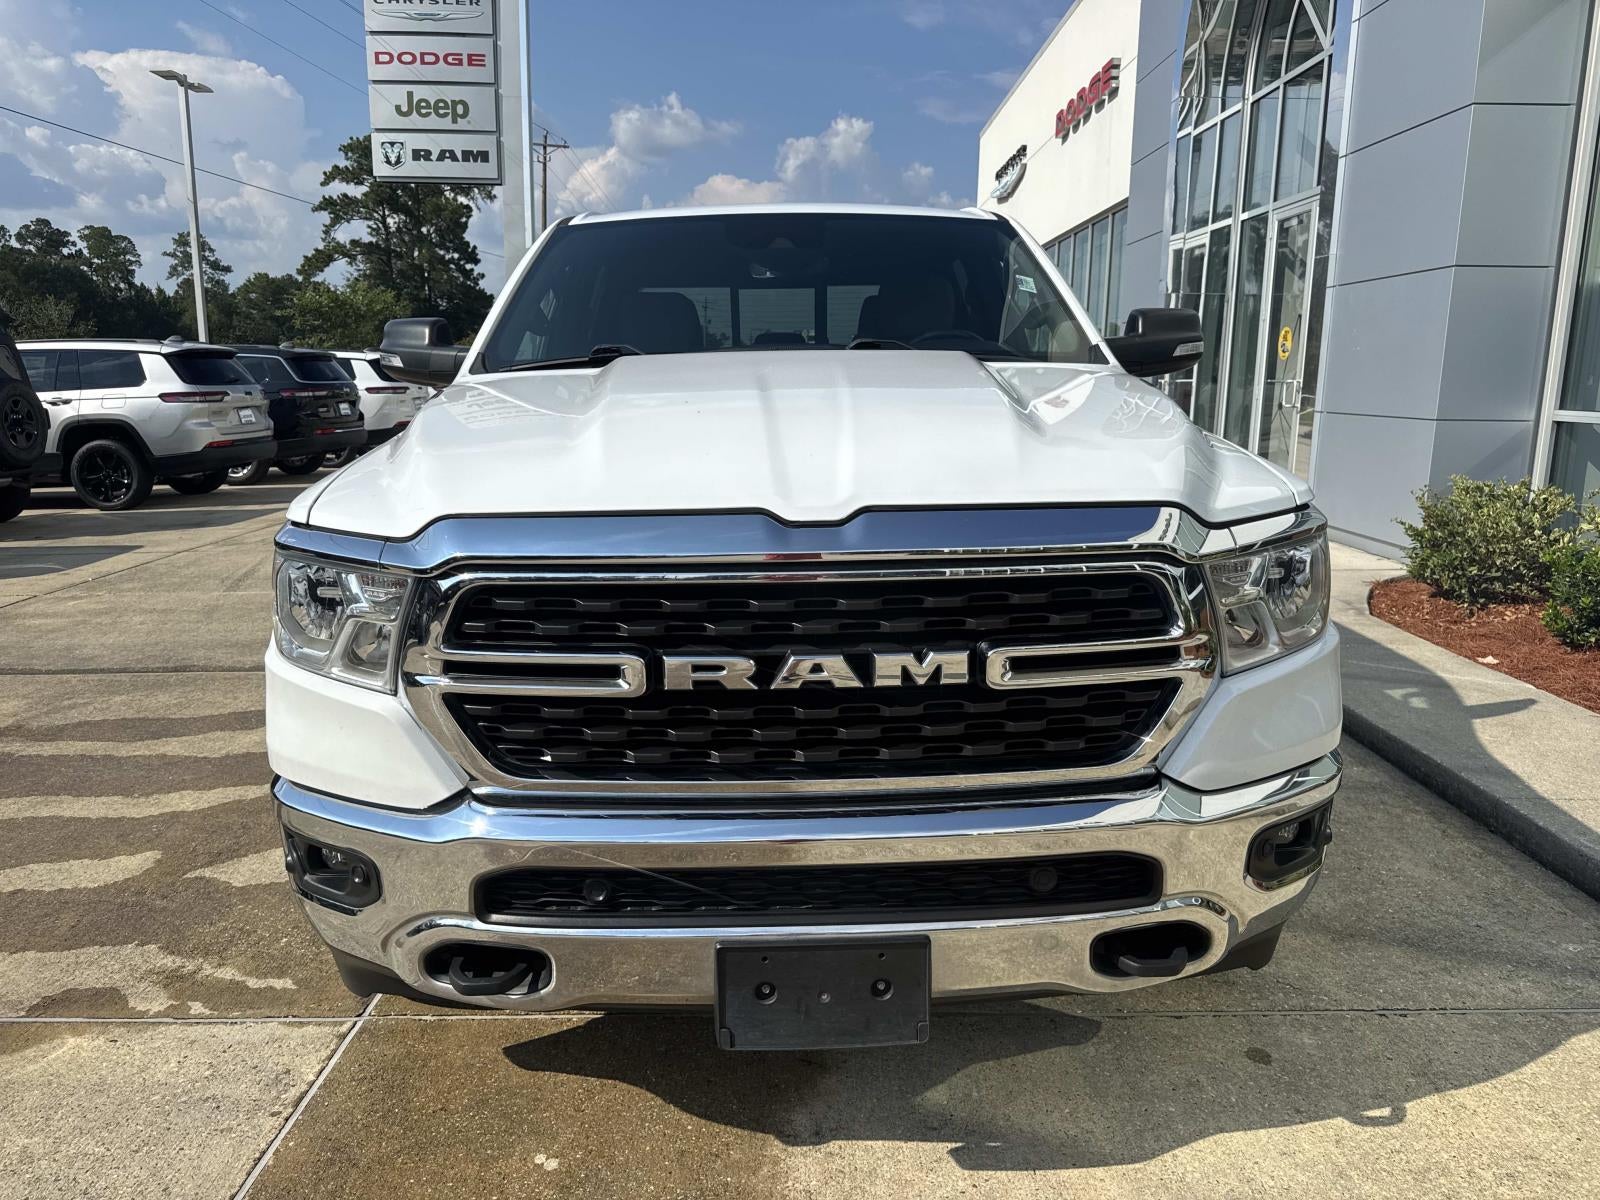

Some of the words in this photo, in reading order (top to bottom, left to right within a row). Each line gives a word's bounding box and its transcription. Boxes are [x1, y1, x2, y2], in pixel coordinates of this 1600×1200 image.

[374, 51, 486, 67] DODGE
[395, 91, 470, 124] Jeep
[1055, 57, 1121, 138] DODGE
[411, 148, 490, 163] RAM
[662, 650, 970, 690] RAM
